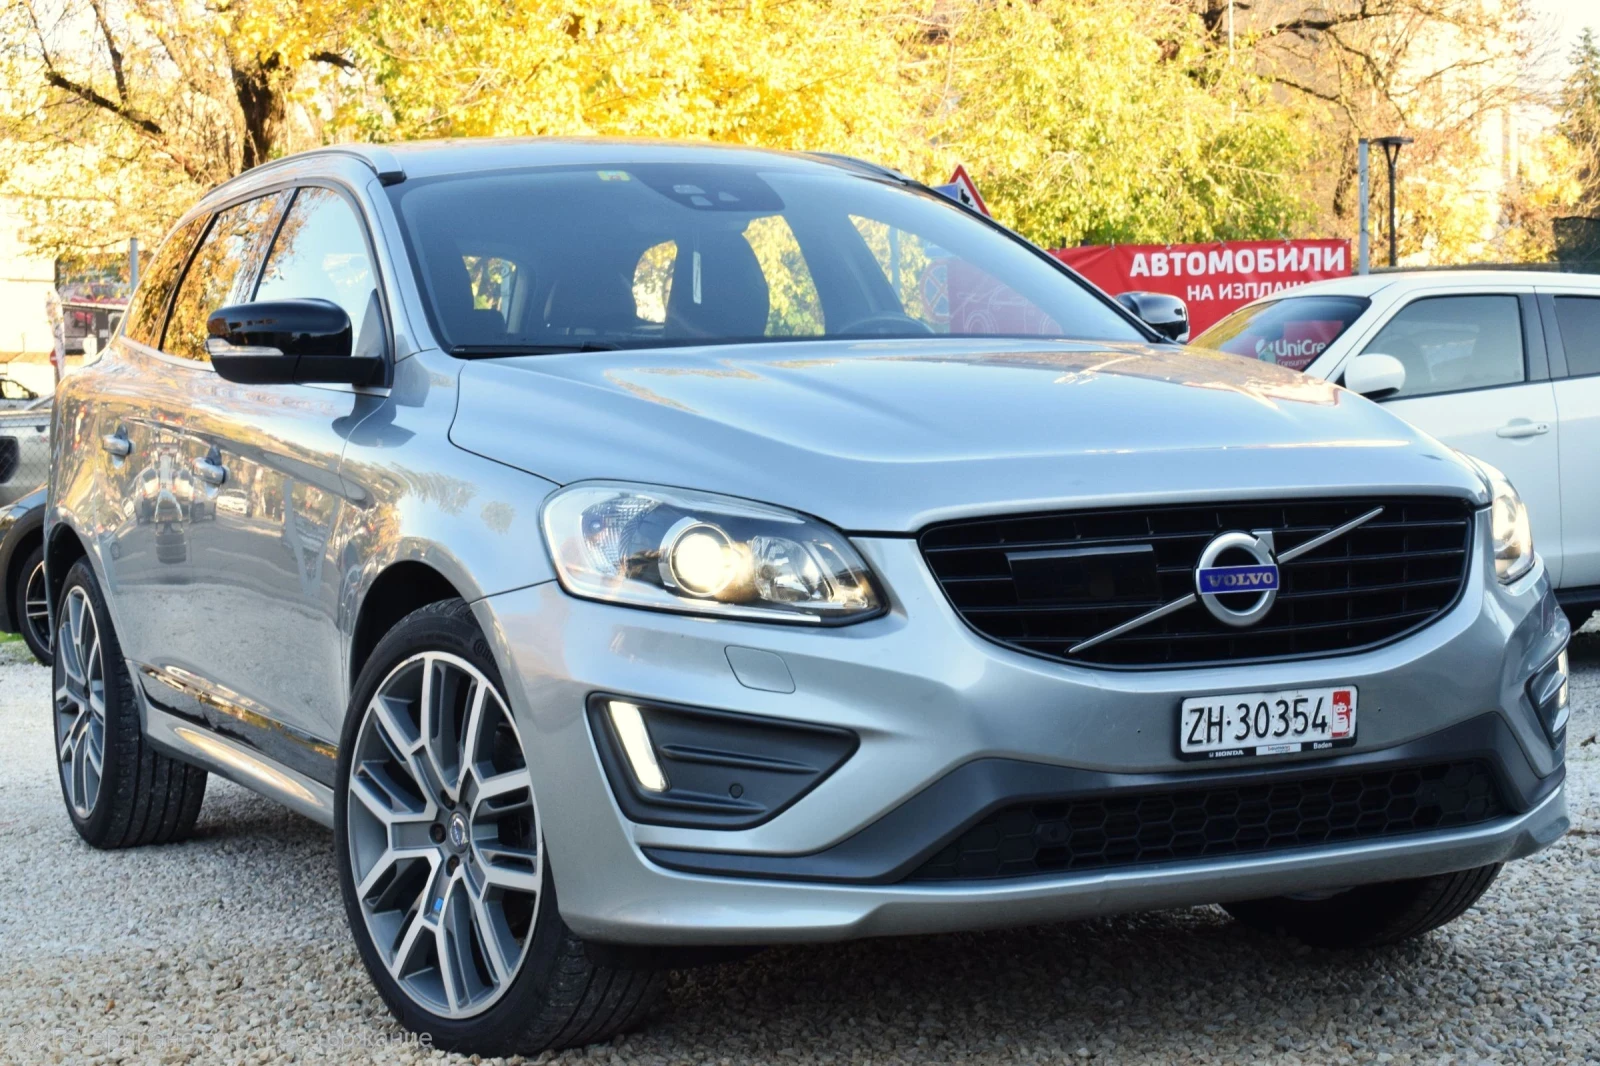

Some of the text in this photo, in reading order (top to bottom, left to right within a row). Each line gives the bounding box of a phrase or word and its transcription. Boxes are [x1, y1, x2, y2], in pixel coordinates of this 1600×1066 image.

[1130, 247, 1344, 277] АВТОМОБИЛИ
[1187, 284, 1214, 301] НА
[1207, 572, 1274, 587] VOLVO
